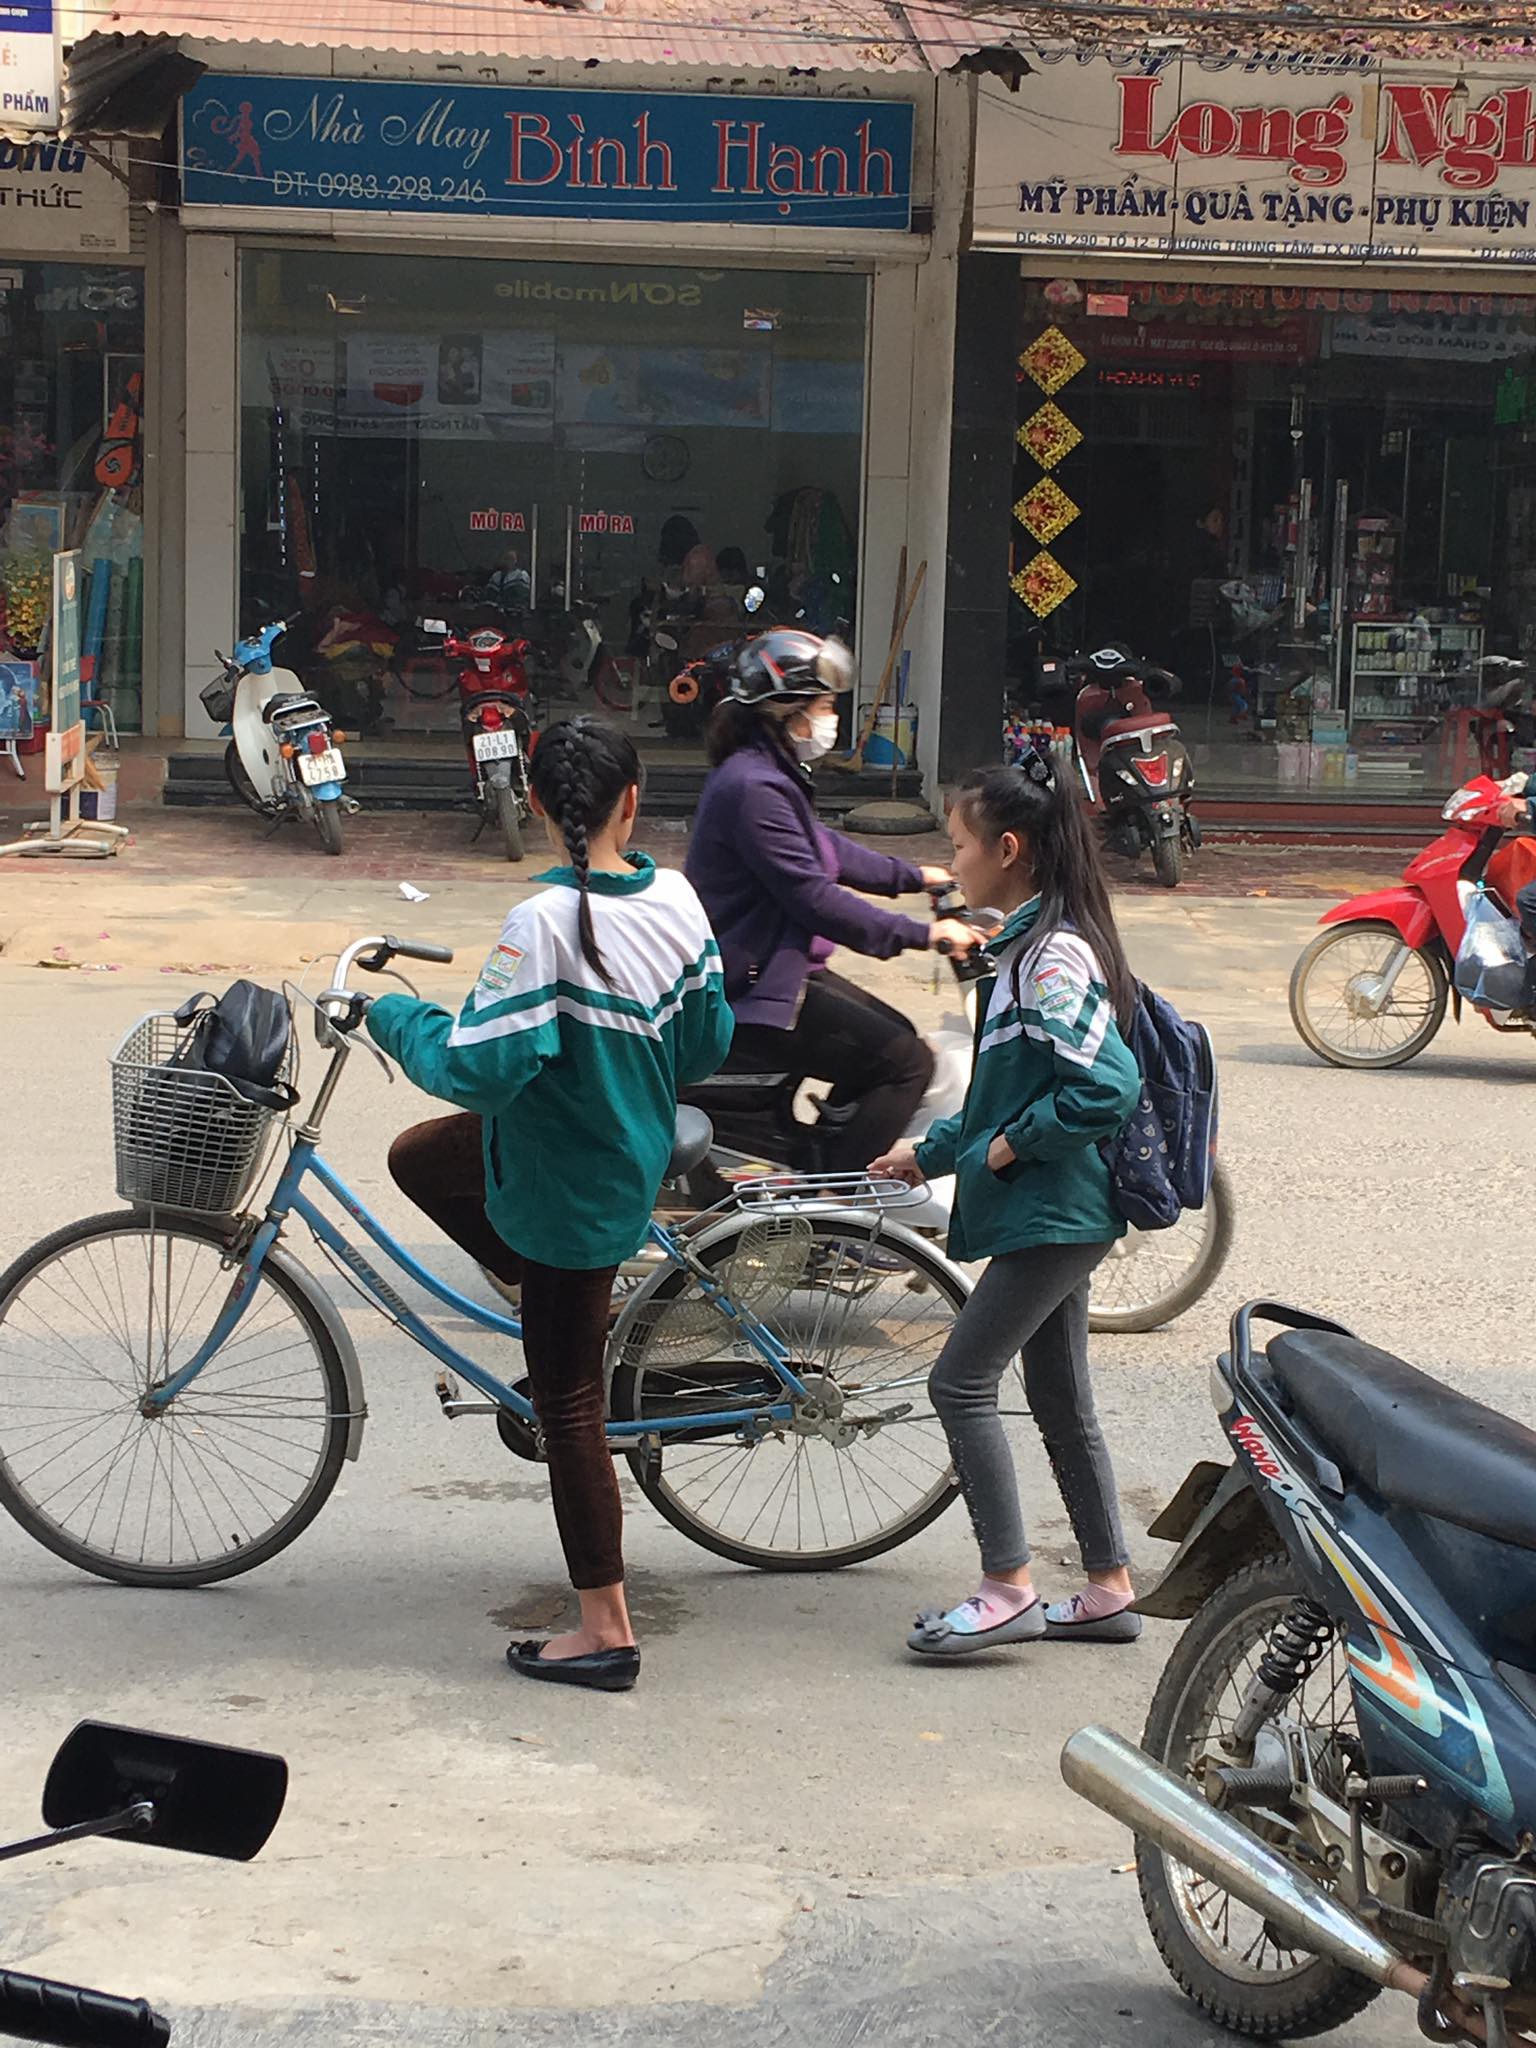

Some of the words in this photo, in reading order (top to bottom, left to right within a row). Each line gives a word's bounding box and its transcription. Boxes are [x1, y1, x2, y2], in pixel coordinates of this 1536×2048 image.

[263, 93, 366, 145] Nhà
[381, 98, 492, 170] May
[1111, 75, 1355, 187] Long
[318, 171, 487, 204] 0983.298.246
[504, 109, 678, 192] Bình
[711, 118, 899, 216] Hạnh
[1019, 174, 1068, 213] MỸ
[1184, 184, 1255, 225] QUÀ
[1262, 186, 1354, 229] TẶNG
[1375, 196, 1442, 232] PHỤ
[1449, 192, 1531, 234] KIỆN
[501, 512, 526, 532] RA
[609, 514, 634, 534] RA
